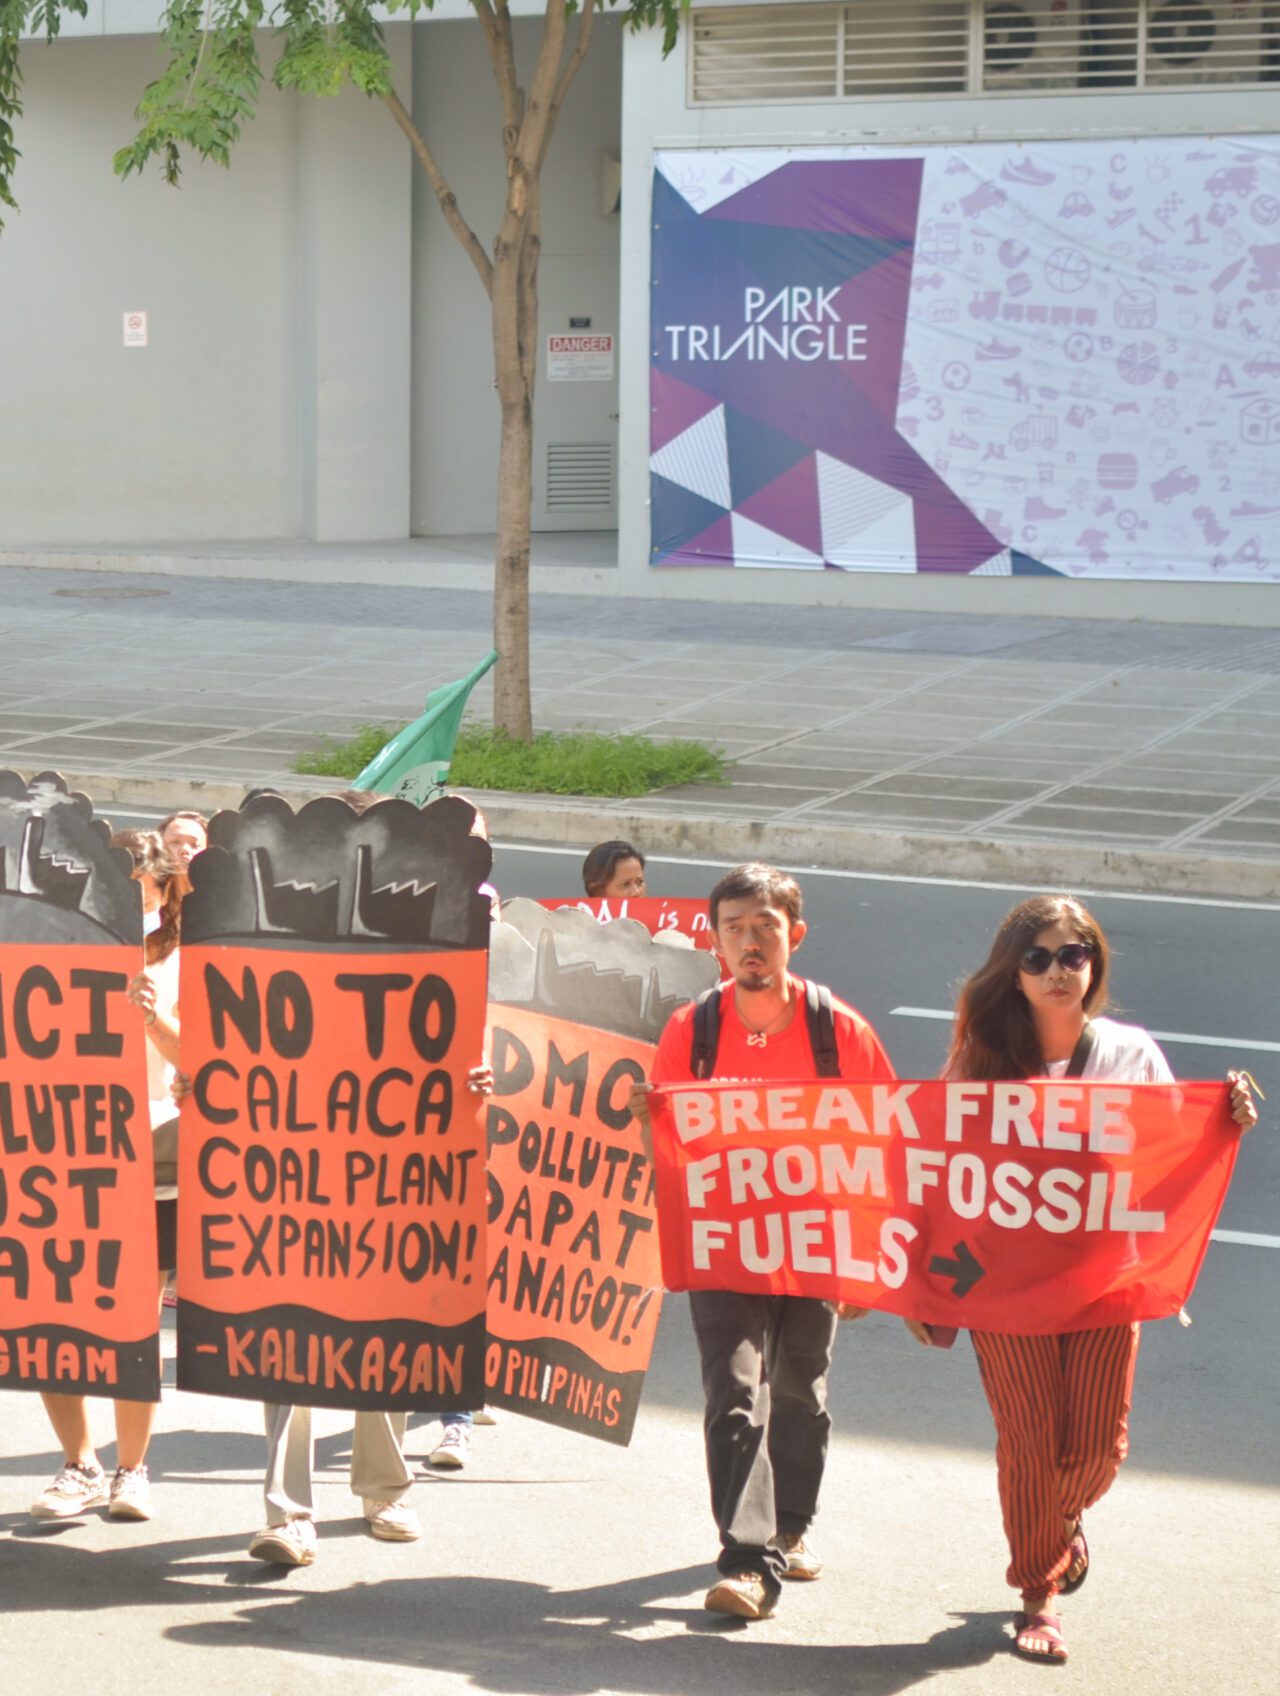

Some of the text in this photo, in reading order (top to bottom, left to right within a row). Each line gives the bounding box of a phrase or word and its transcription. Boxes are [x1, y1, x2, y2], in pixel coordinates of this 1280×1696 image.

[745, 286, 842, 323] PARK
[552, 337, 612, 351] DANGER
[665, 324, 867, 361] TRIANGLE
[657, 901, 680, 930] is
[203, 961, 458, 1064] NO TO
[192, 1059, 455, 1139] CALACA
[671, 1082, 1133, 1154] BREAK FREE
[197, 1136, 479, 1207] COAL PLANT
[686, 1143, 1167, 1233] FROM FOSSIL
[200, 1213, 479, 1286] EXPANSION!
[691, 1209, 920, 1289] FUELS
[488, 1246, 651, 1348] ANAGOT!
